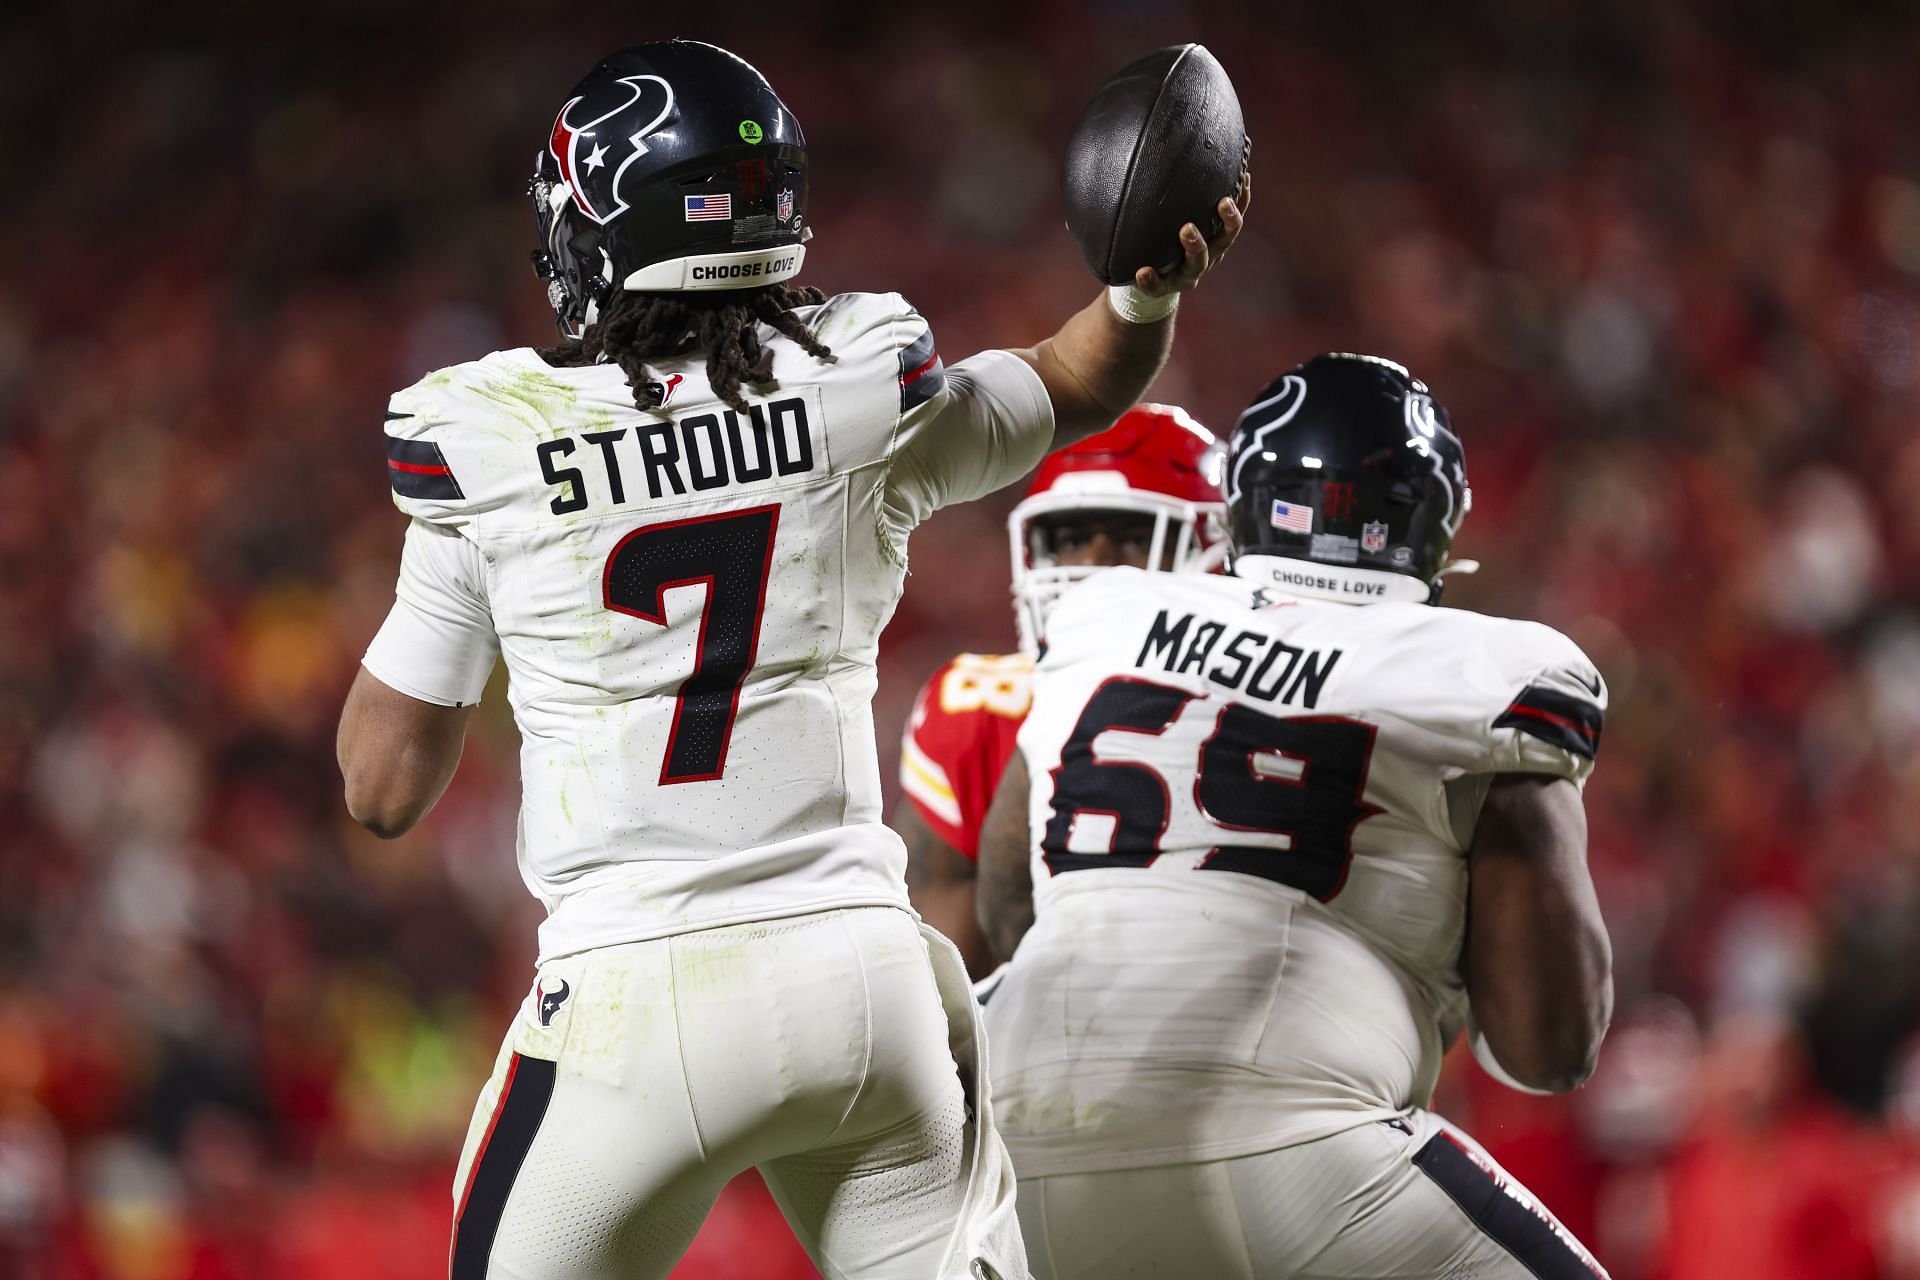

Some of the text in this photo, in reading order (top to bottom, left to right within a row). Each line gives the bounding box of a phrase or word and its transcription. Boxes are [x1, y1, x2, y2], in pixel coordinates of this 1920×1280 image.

[692, 257, 795, 280] CHOOSE LOVE
[536, 397, 814, 516] STROUD
[1272, 569, 1387, 596] CHOOSE LOVE
[602, 502, 782, 786] 7
[1134, 609, 1342, 709] MASON
[1041, 674, 1388, 904] 69
